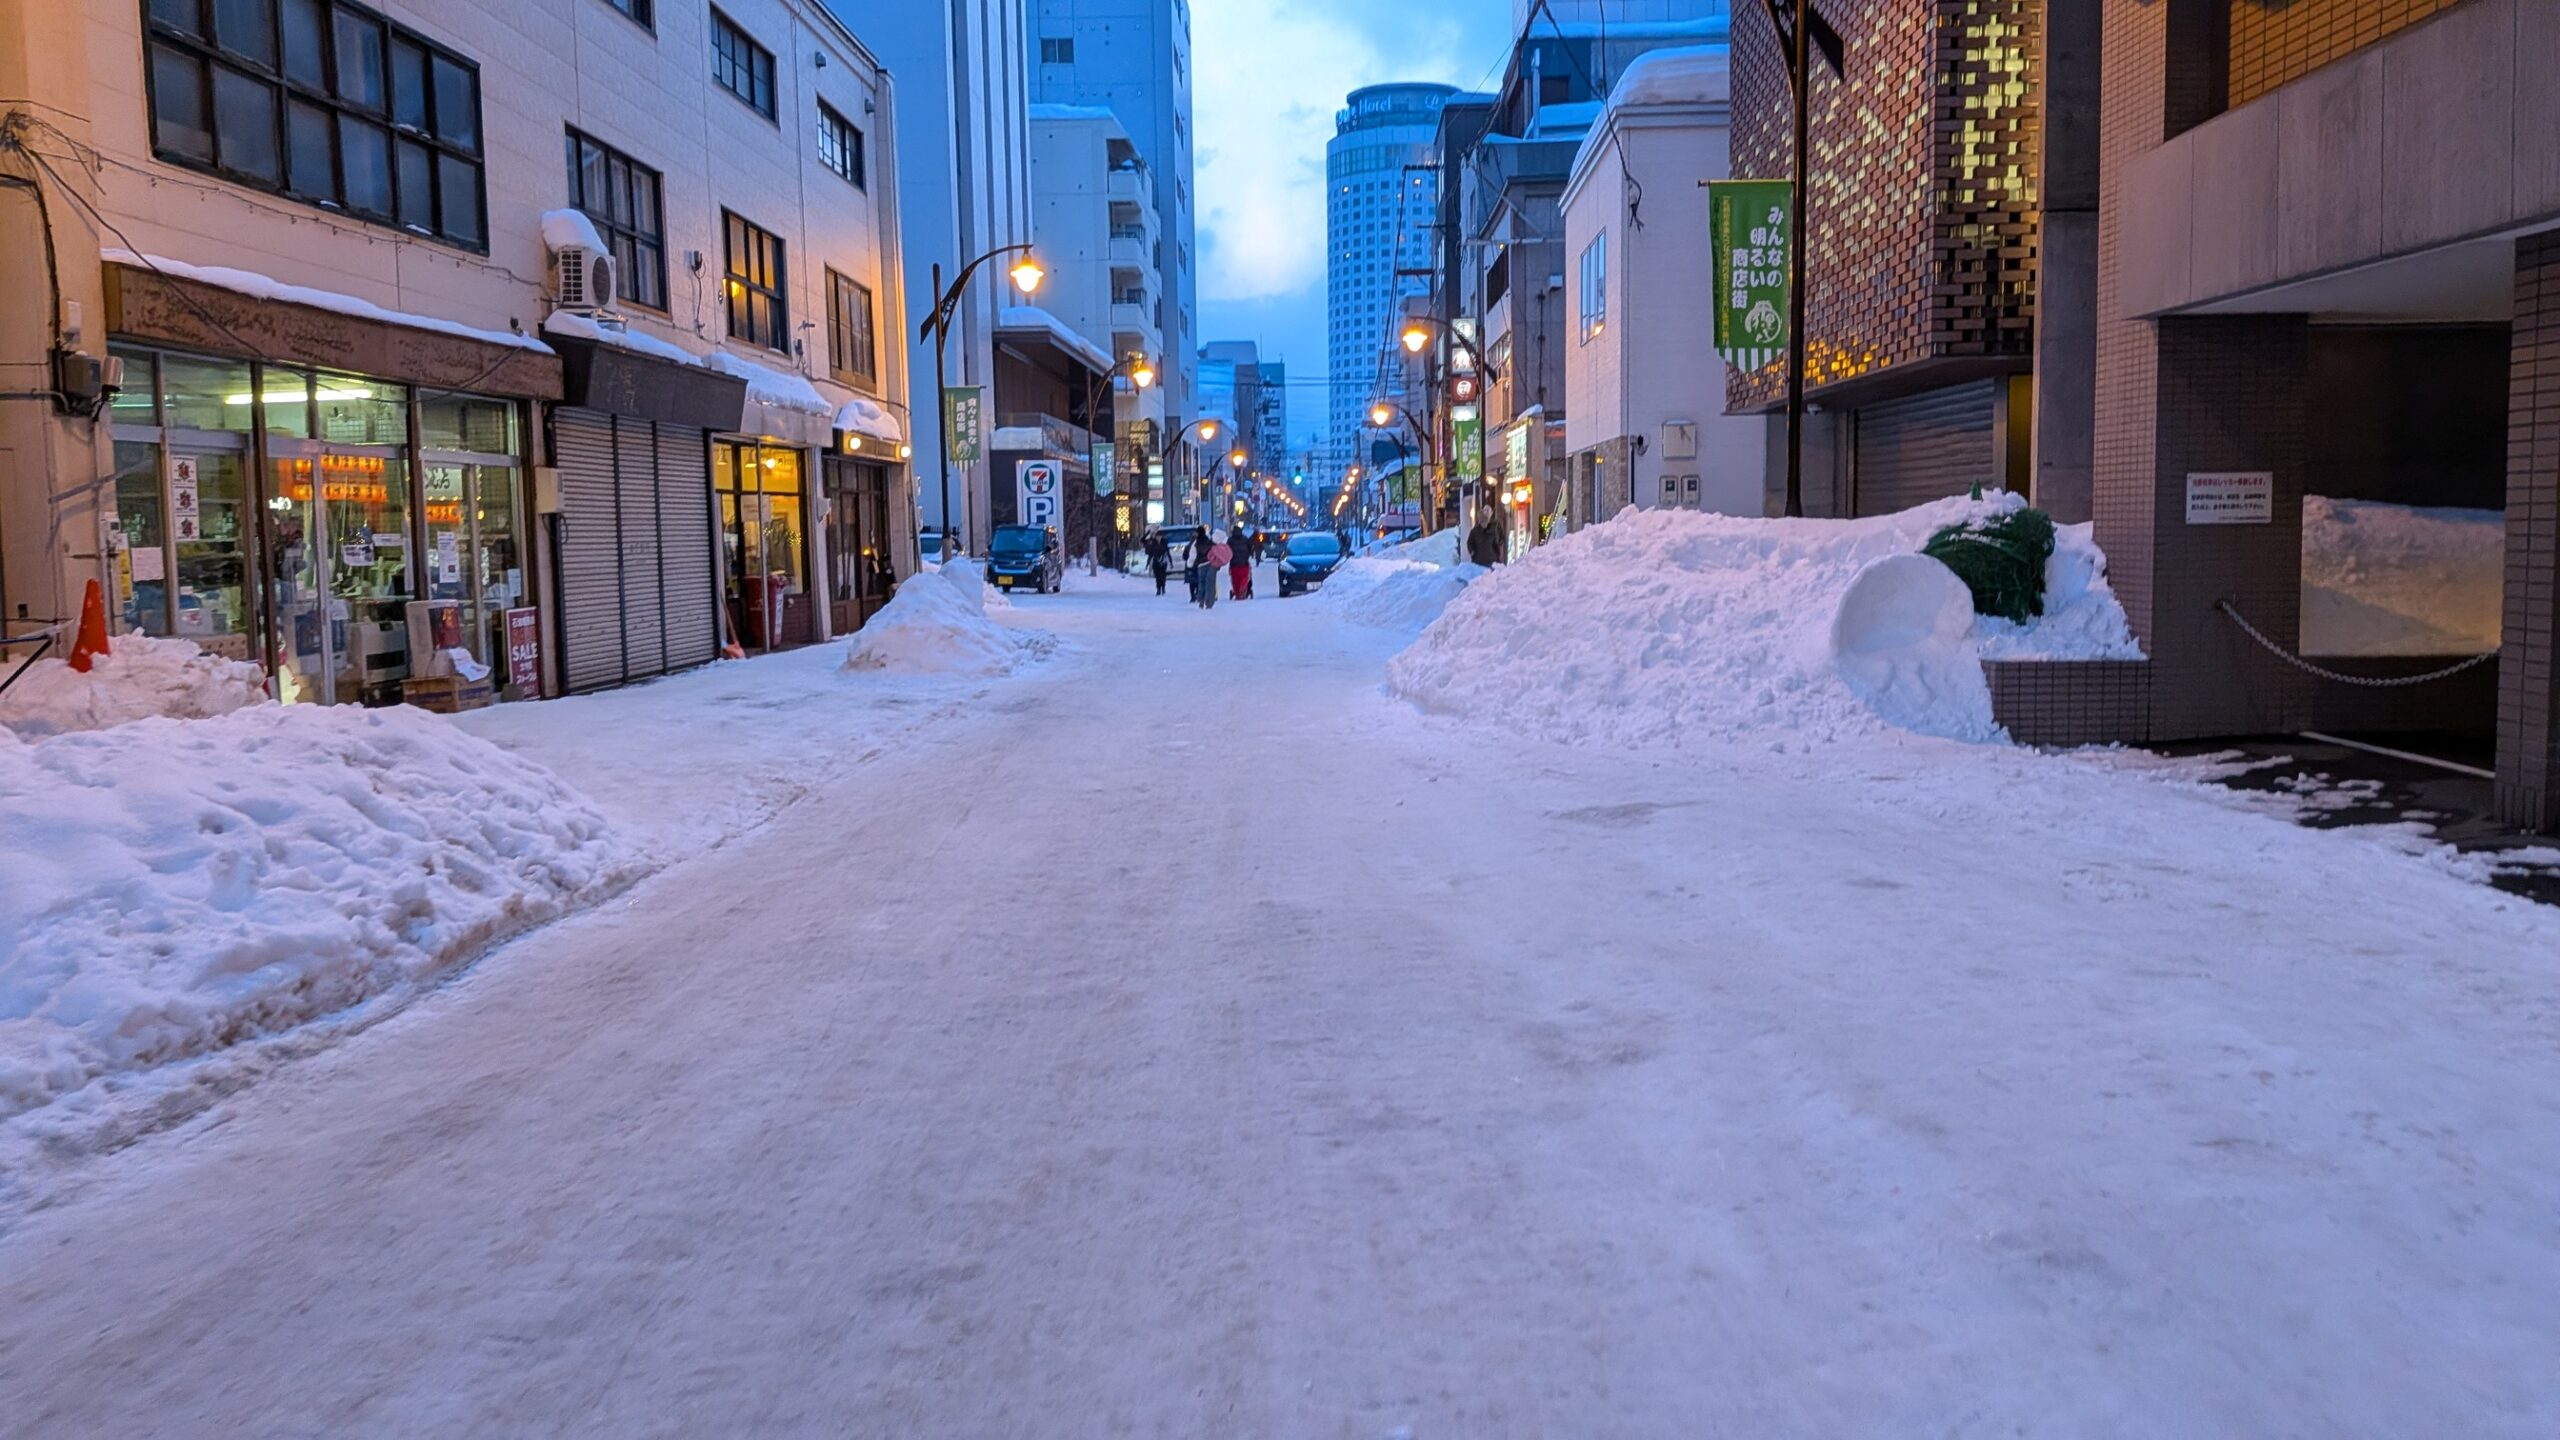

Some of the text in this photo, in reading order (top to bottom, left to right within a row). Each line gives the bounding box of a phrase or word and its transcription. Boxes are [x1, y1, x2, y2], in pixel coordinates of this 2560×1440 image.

[1359, 95, 1391, 116] Hotel
[1750, 227, 1767, 287] 明るい
[1767, 206, 1784, 289] みんなの
[1731, 248, 1749, 309] 商店街
[1031, 470, 1048, 493] 7
[1030, 498, 1051, 523] P
[512, 643, 538, 662] SALE
